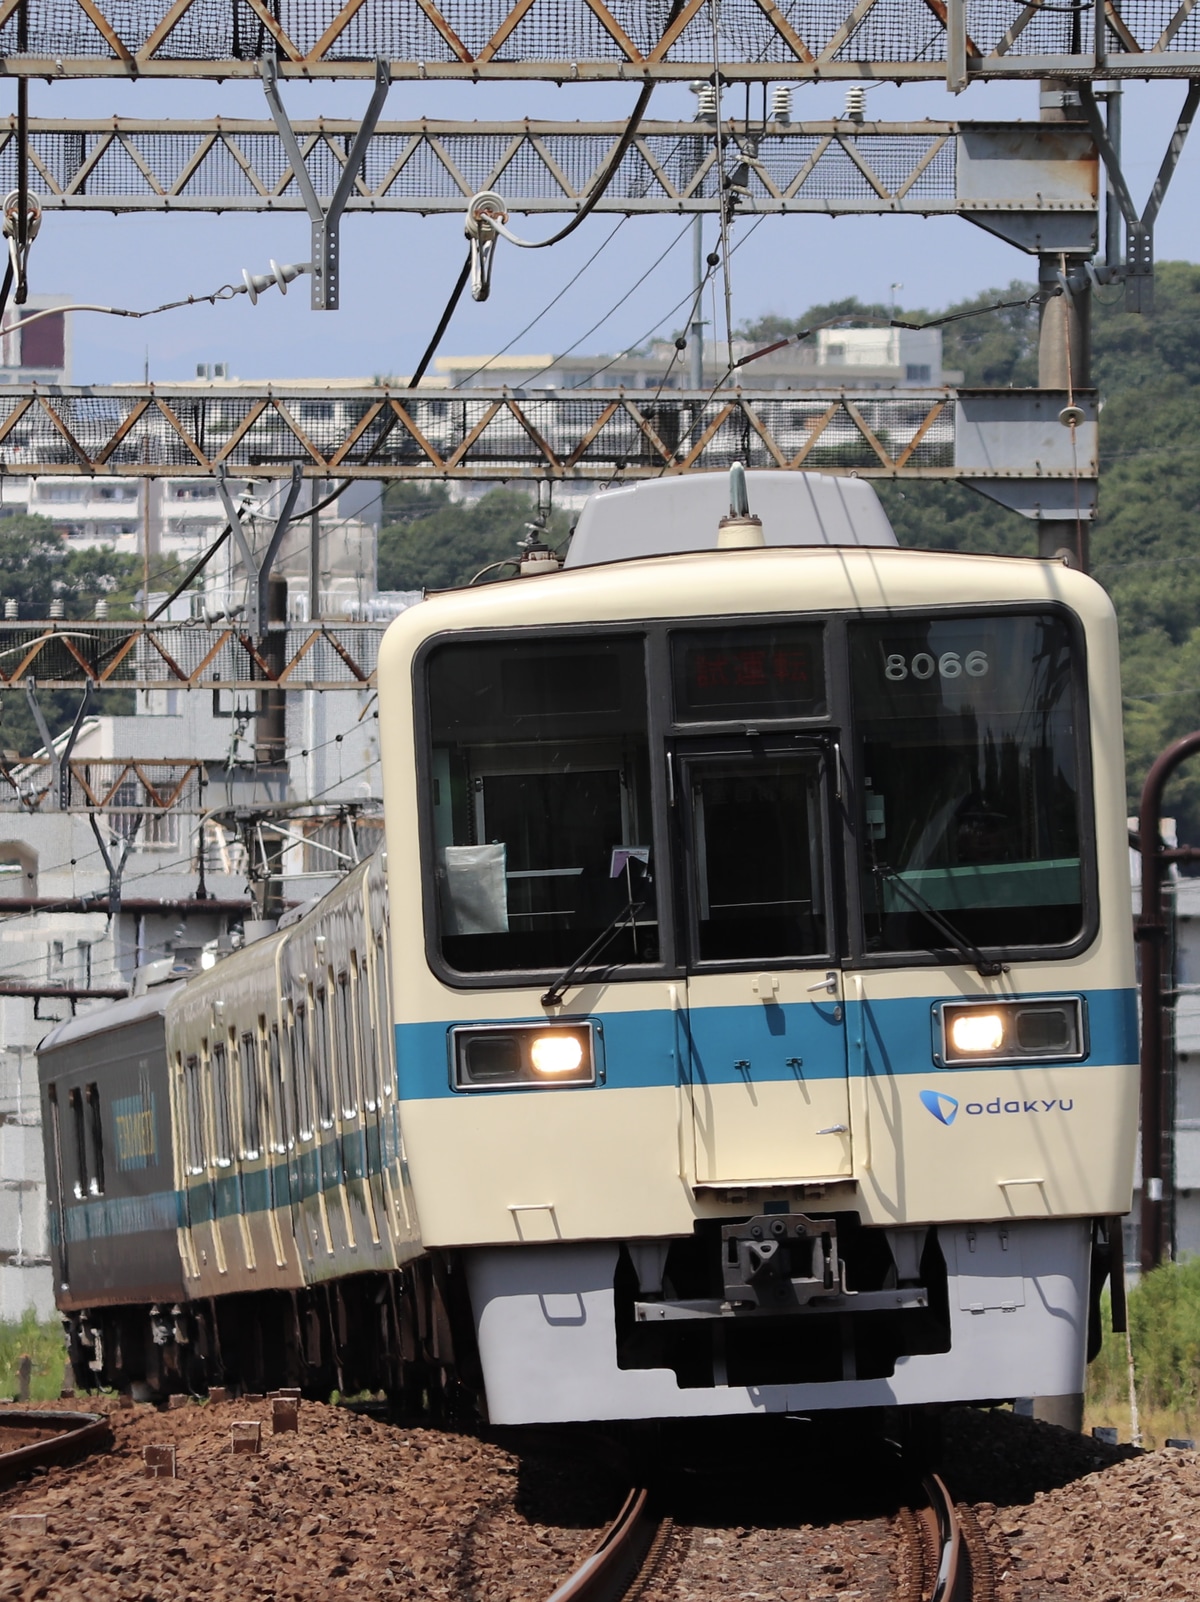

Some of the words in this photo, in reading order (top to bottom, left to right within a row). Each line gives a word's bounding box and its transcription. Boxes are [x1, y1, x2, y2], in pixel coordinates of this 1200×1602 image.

[696, 651, 808, 687] 試運転
[885, 651, 988, 680] 8066
